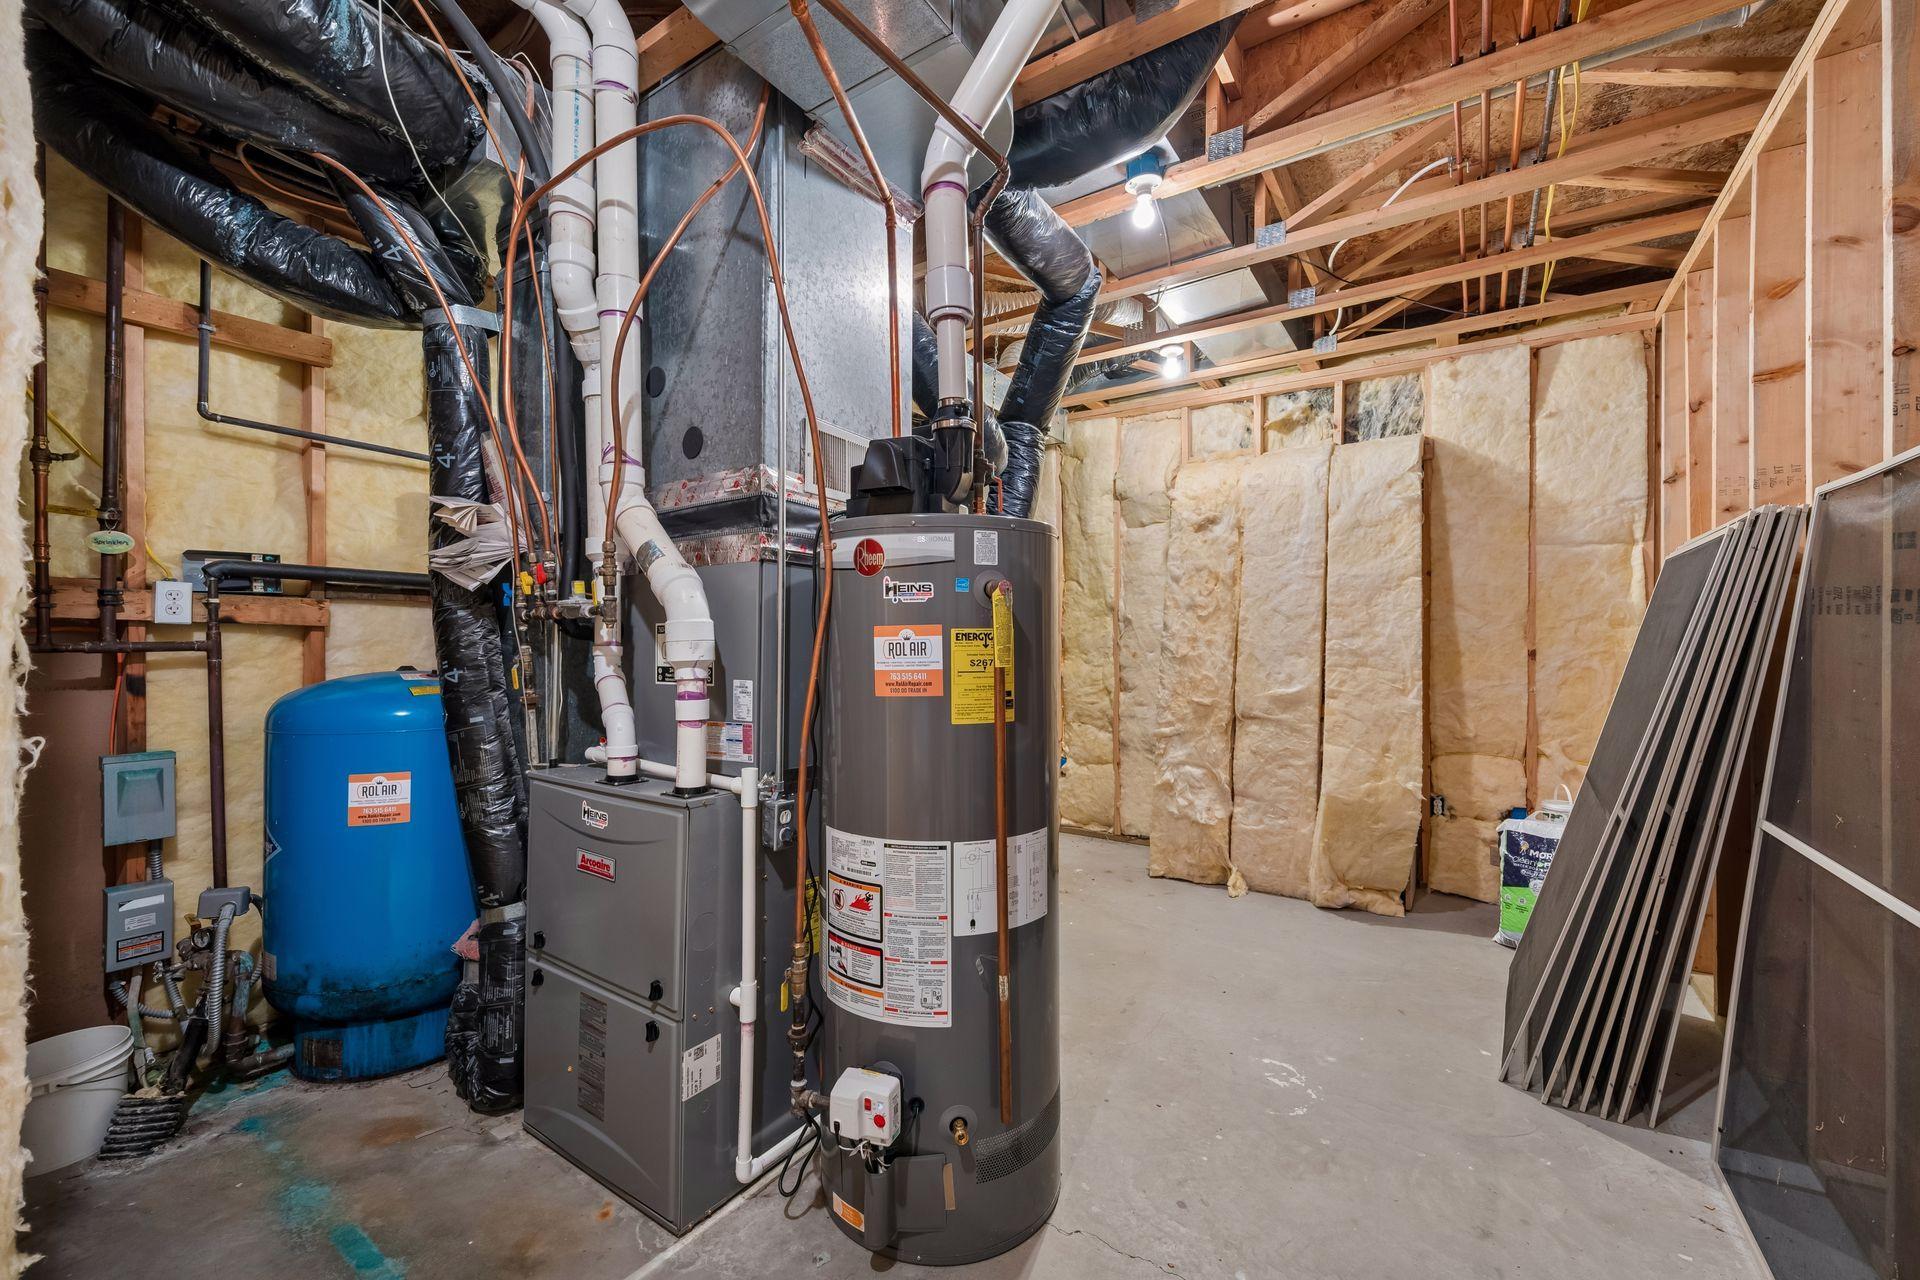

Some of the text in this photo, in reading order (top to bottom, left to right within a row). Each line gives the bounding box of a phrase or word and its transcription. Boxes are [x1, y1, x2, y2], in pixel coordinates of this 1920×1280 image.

[434, 443, 456, 469] 4"
[857, 540, 883, 571] Rheem
[885, 583, 932, 597] HEINS
[888, 641, 927, 659] ROL AIR
[443, 660, 463, 684] 4"
[890, 672, 927, 680] 763 515 6411
[362, 784, 397, 799] ROL AIR
[583, 806, 607, 821] HEINS
[581, 853, 611, 871] Arcoaire
[1530, 849, 1554, 860] MOR
